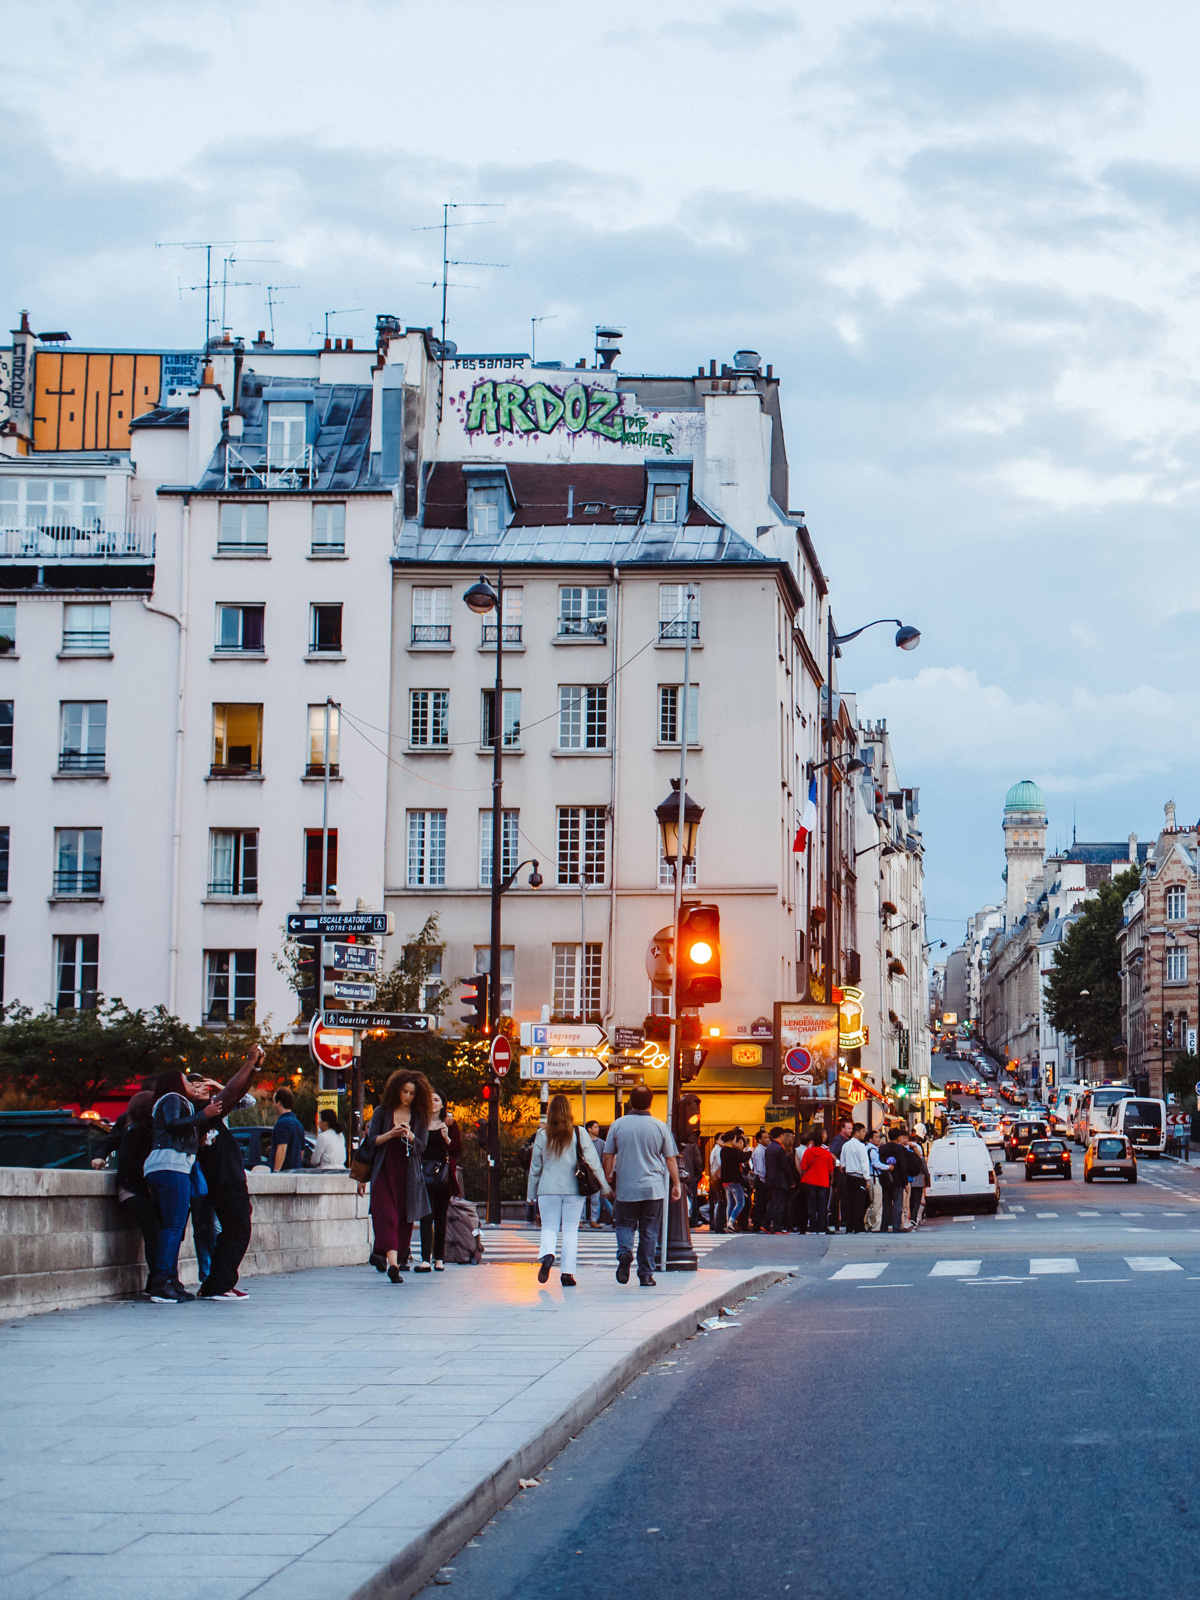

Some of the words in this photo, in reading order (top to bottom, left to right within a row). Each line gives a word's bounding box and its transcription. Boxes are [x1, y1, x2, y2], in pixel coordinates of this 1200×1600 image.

[467, 379, 625, 442] ARDOZ
[319, 916, 372, 924] ESCALE-BATOBUS
[339, 1016, 368, 1025] Quartier
[372, 1017, 391, 1026] Latin
[784, 1019, 831, 1027] LENDEMAINS
[549, 1032, 580, 1041] Lagrange
